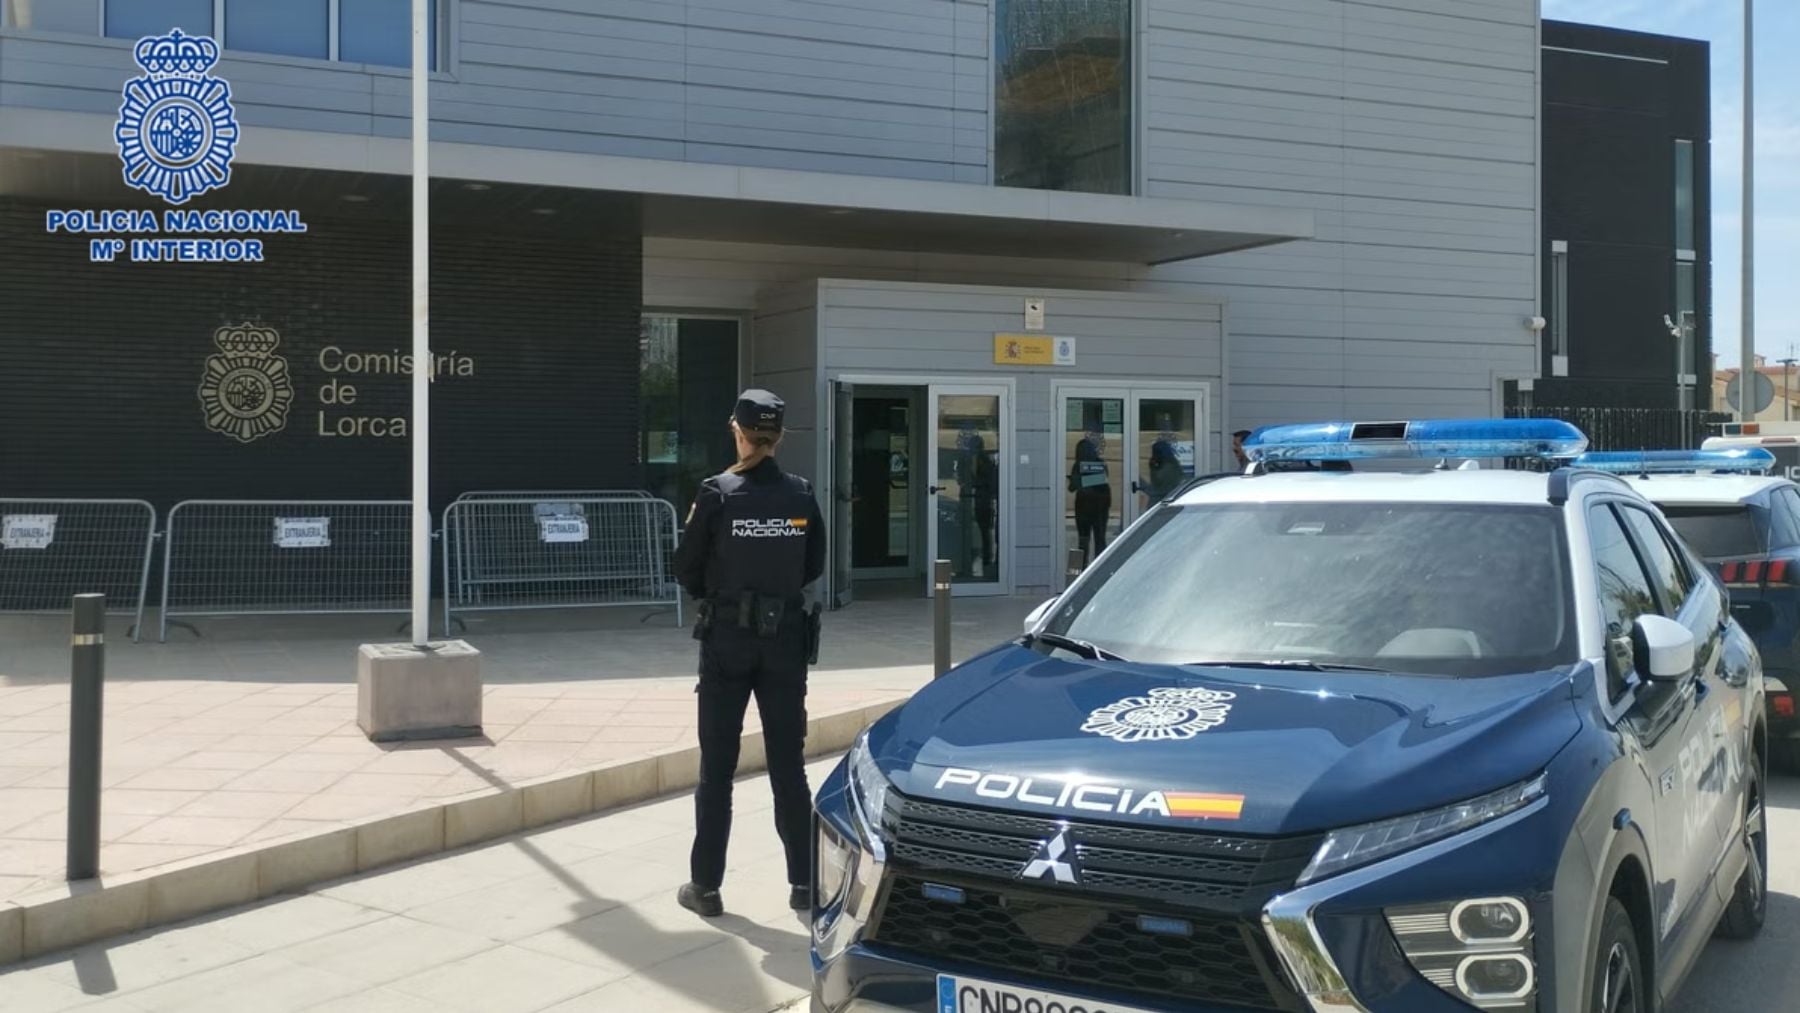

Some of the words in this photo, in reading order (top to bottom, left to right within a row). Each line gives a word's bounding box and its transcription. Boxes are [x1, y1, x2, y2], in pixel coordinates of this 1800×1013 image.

[319, 346, 474, 377] Comisría
[319, 378, 357, 405] de
[319, 410, 407, 438] Lorca
[731, 527, 806, 538] NACIONAL
[732, 518, 793, 528] POLICIA
[934, 766, 1171, 817] POLICIA
